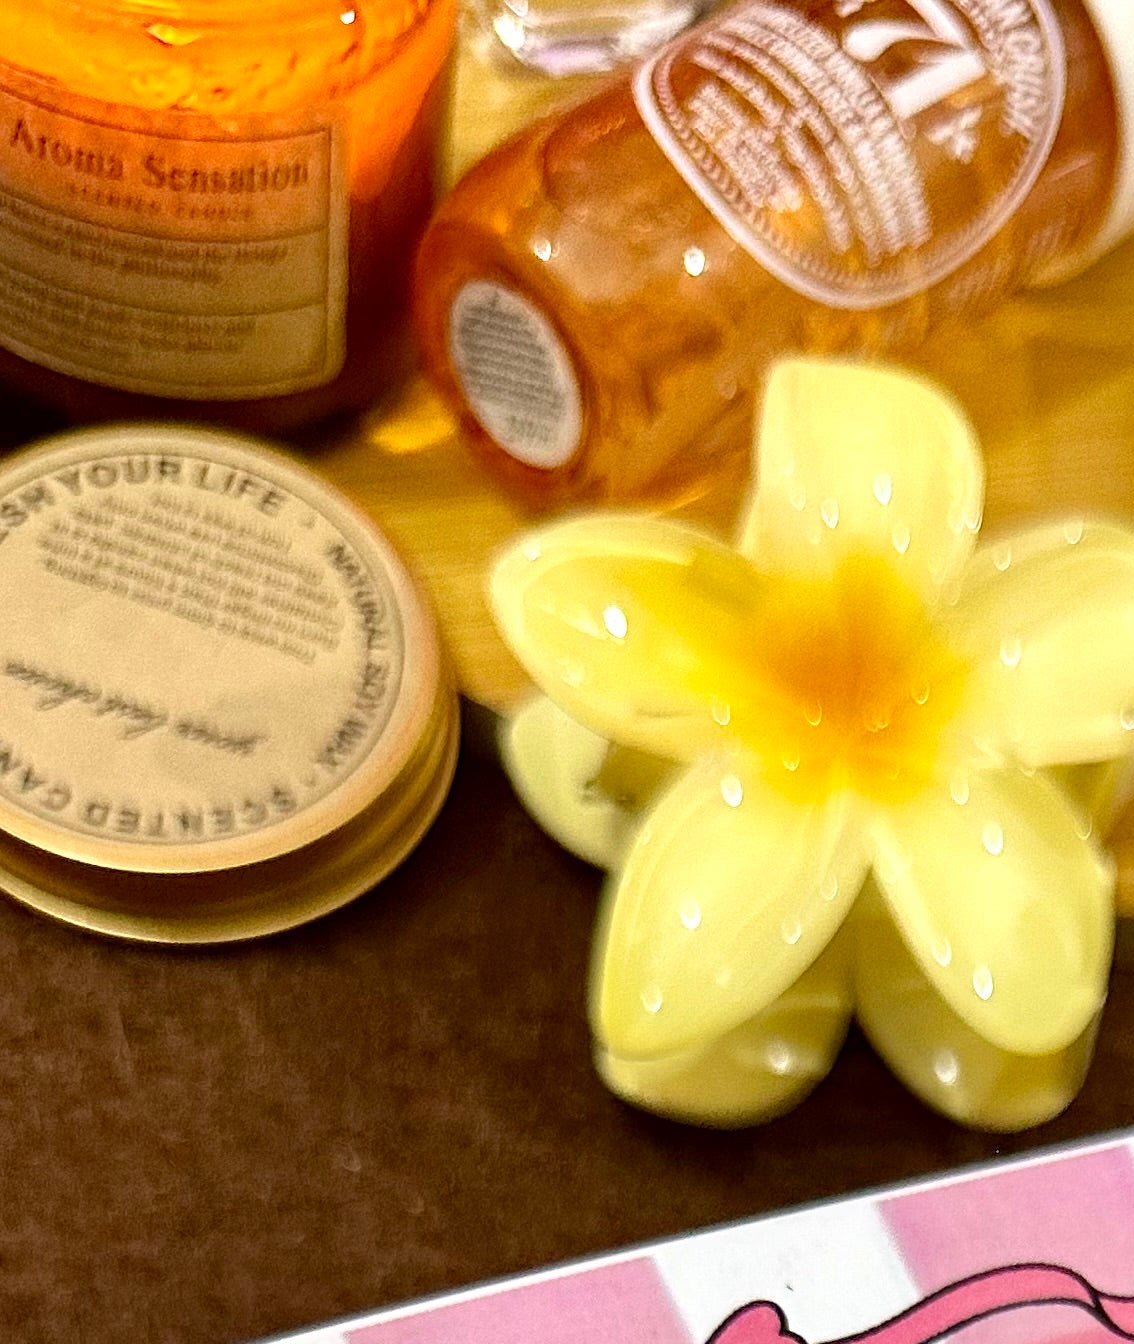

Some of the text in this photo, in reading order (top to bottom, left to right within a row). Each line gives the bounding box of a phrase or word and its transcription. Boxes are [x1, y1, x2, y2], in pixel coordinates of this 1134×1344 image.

[10, 118, 309, 194] Aroma Sensation
[55, 457, 184, 497] YOUR
[191, 461, 286, 517] LIFE
[82, 783, 298, 836] SCENTED
